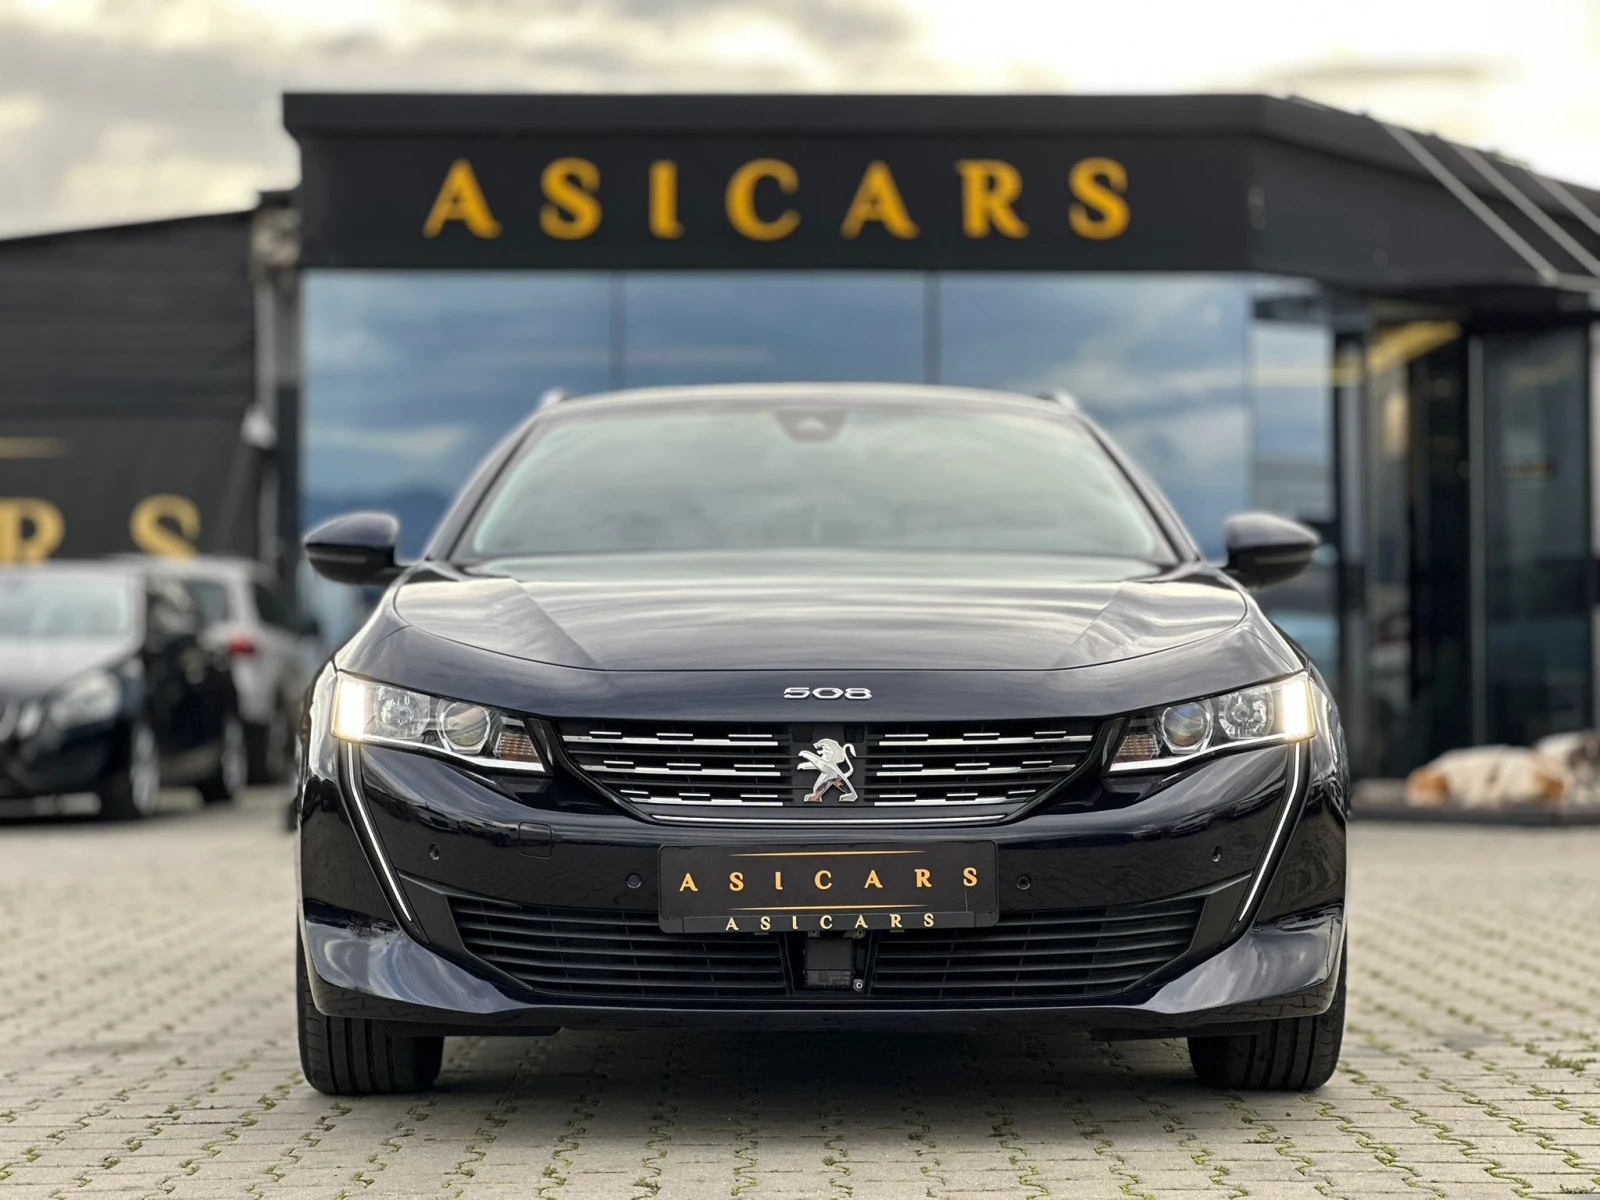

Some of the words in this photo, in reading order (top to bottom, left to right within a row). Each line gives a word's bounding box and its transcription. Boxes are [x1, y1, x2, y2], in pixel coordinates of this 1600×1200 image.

[425, 157, 1130, 240] ASICARS
[783, 687, 873, 700] 508
[680, 867, 979, 892] ASICARS
[725, 912, 935, 931] ASICARS
